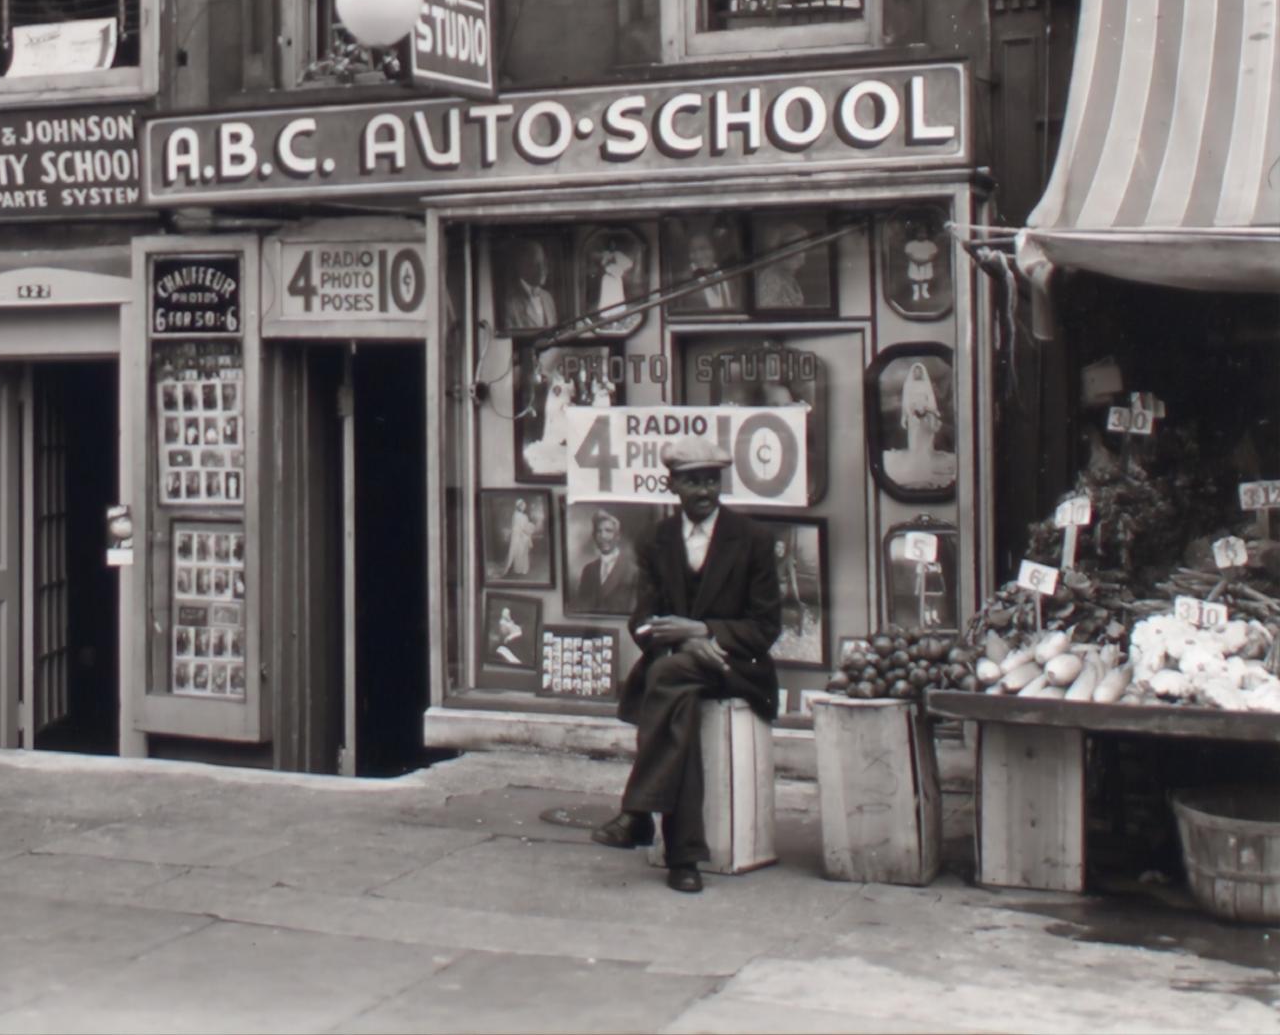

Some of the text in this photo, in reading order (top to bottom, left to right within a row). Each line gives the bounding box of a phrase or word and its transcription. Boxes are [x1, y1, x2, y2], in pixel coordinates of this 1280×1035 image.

[416, 3, 487, 67] STUDIO
[1, 127, 16, 146] &
[165, 116, 336, 183] A.B.C.
[320, 251, 374, 268] RADIO
[156, 266, 236, 299] CHAUFFEUR
[287, 249, 319, 313] 4
[320, 271, 374, 289] PHOTO
[171, 292, 219, 303] PHOTOS
[320, 294, 374, 312] POSES
[156, 307, 167, 331] 6
[168, 311, 192, 326] FOR
[563, 351, 817, 384] PHOTO STUDIO
[626, 415, 708, 436] RADIO
[574, 414, 620, 493] 4
[634, 473, 671, 494] POS
